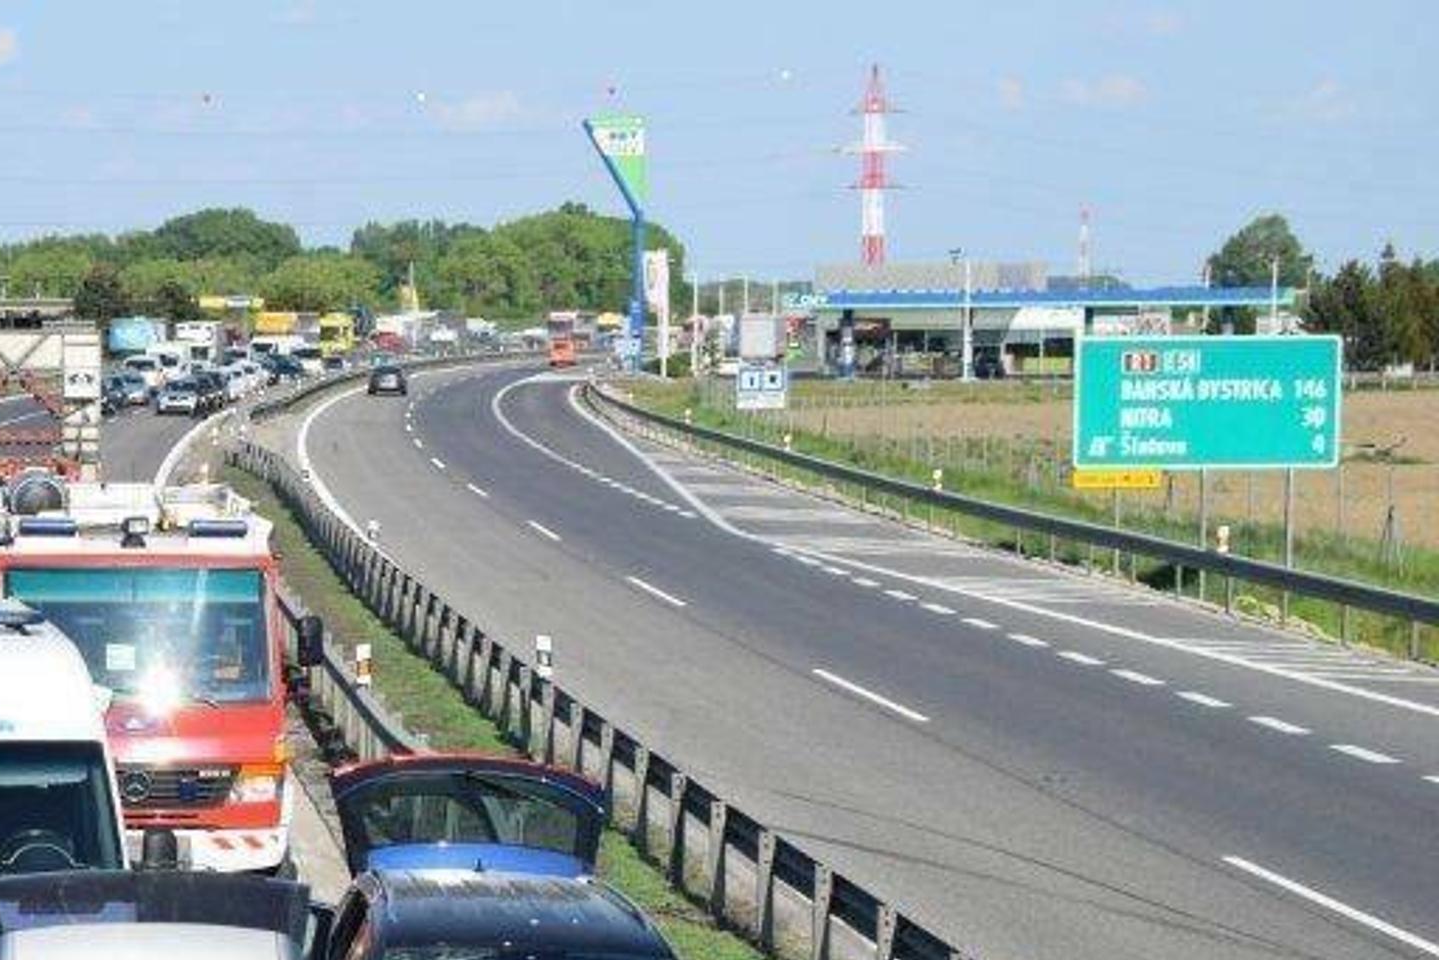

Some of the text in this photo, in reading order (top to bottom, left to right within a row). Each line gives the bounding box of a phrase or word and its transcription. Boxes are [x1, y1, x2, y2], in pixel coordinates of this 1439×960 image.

[1121, 377, 1327, 401] BANSKÁ BYSTRICA 146
[1121, 407, 1172, 429] NITRA
